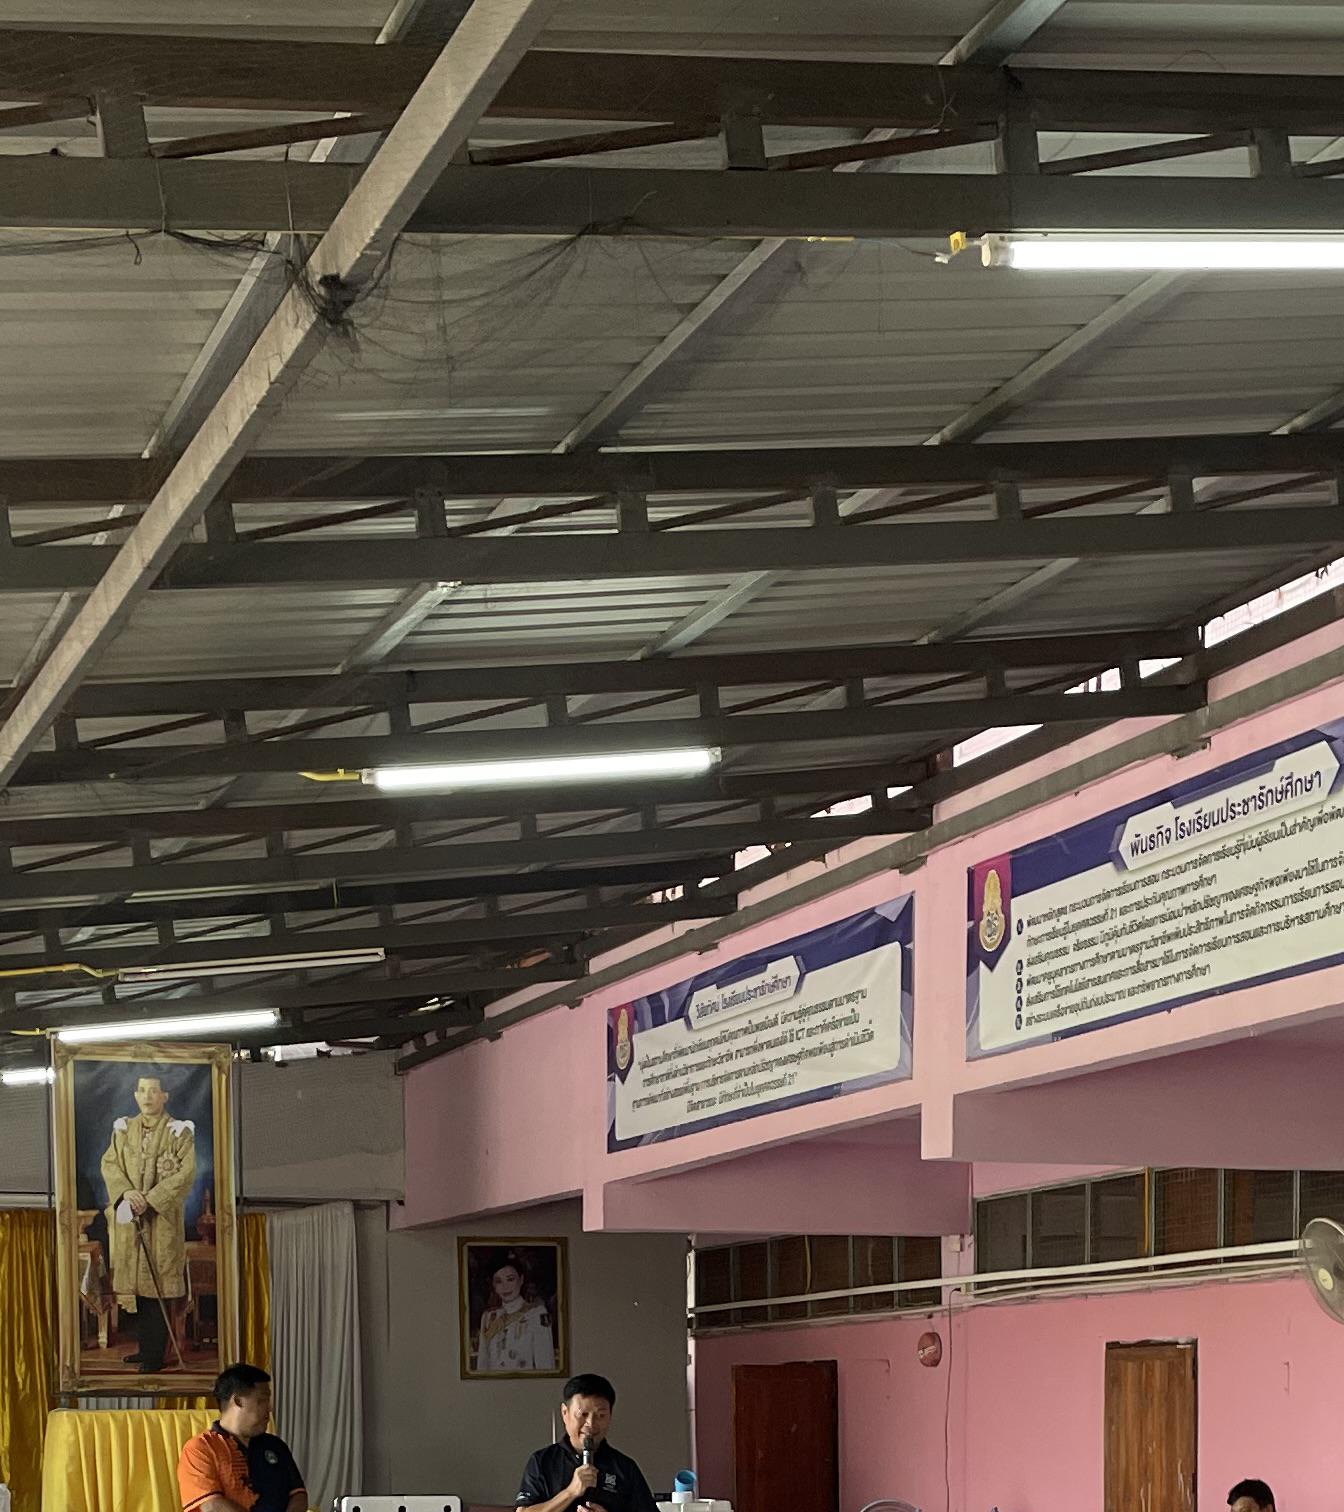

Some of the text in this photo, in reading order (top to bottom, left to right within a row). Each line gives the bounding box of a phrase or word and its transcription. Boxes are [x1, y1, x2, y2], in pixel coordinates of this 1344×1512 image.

[1129, 770, 1322, 858] พันธกิจ โรงเรียนประชารักษ์ศึกษา
